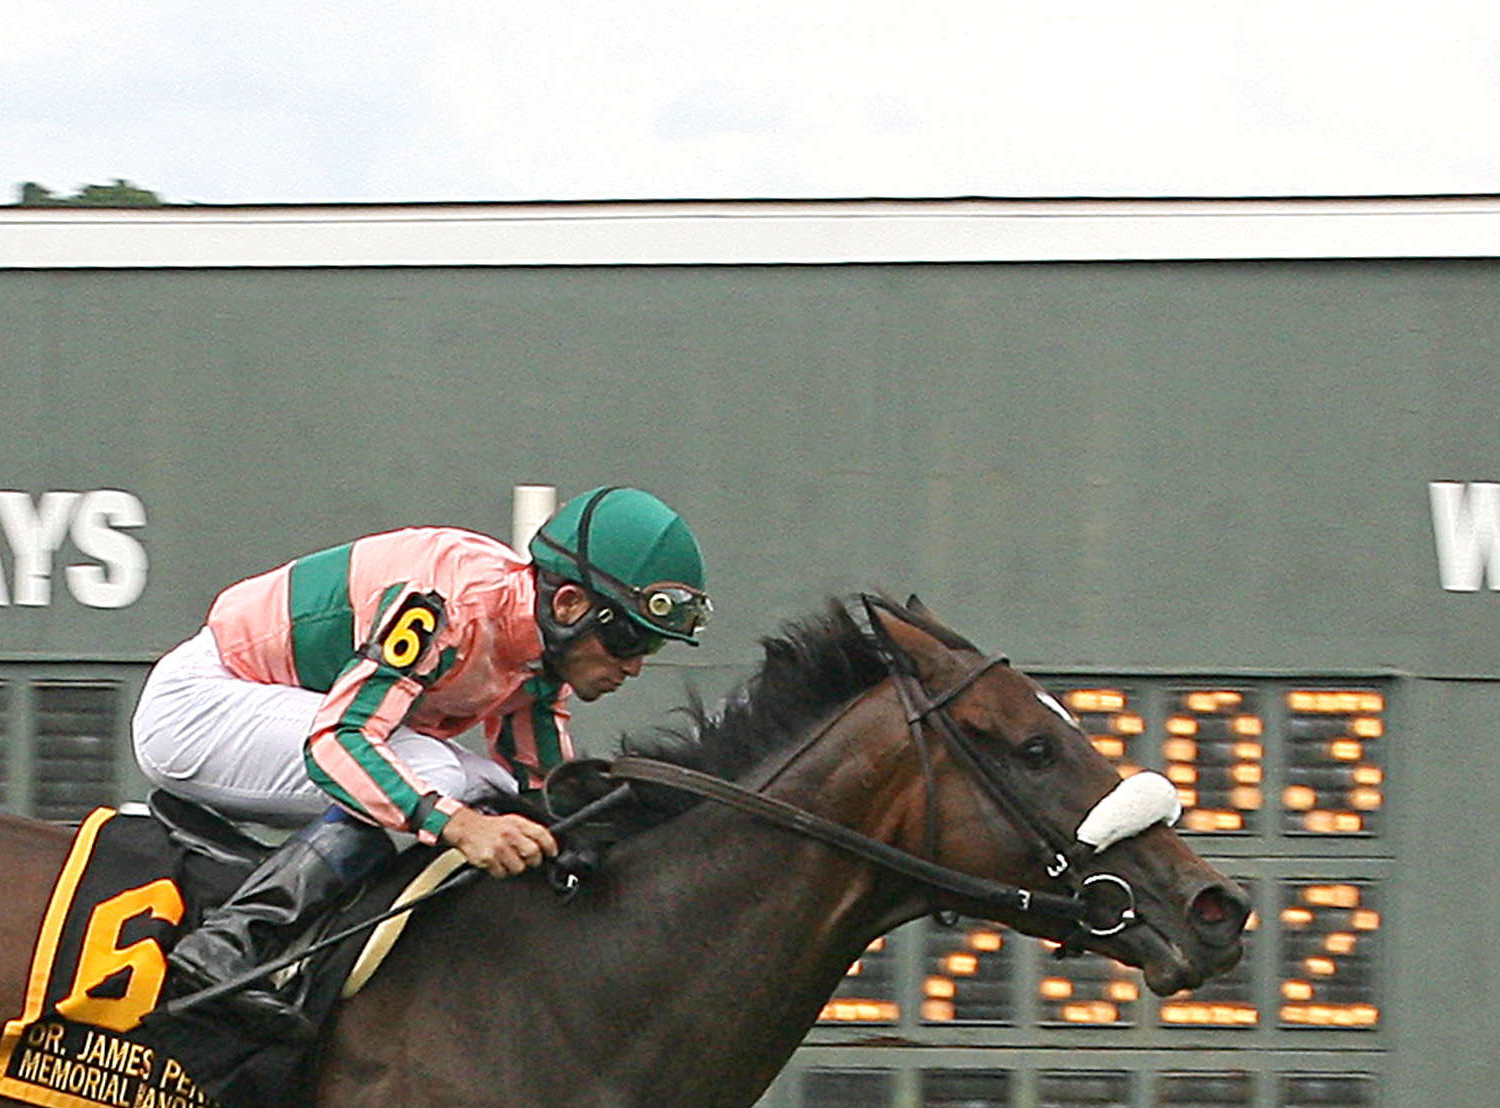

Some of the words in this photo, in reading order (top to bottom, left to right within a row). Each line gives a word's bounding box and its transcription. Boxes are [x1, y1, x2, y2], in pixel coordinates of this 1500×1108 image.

[383, 607, 435, 668] 6
[55, 877, 186, 1034] 6
[18, 1048, 130, 1107] MEMORIAL
[77, 1030, 153, 1081] JAMES
